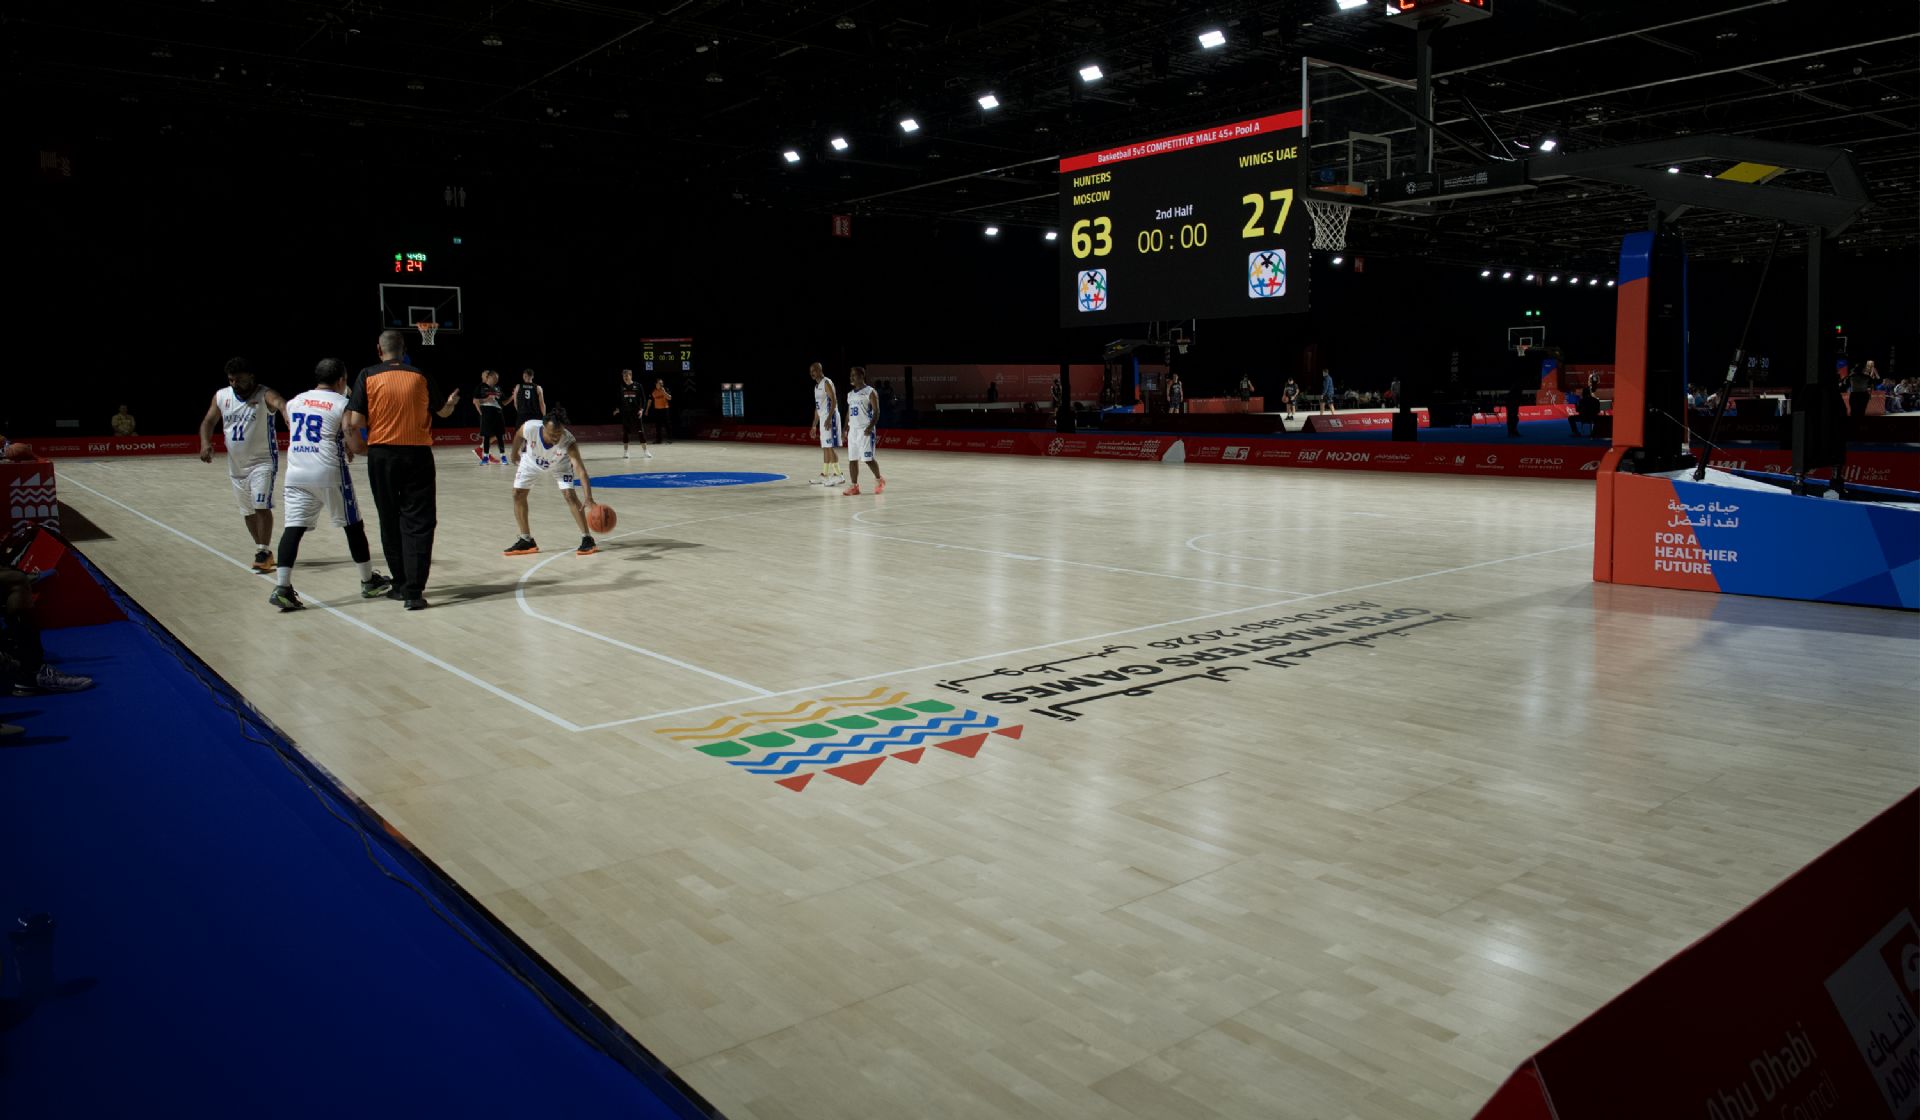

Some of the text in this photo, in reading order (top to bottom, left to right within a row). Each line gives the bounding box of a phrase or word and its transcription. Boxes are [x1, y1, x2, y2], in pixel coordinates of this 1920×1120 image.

[1097, 121, 1261, 163] Basketball 5v5 COMPETITIVE MALE 45+ Pool A
[1239, 147, 1298, 168] WINGS UAE
[1073, 171, 1112, 188] HUNTERS
[1073, 190, 1111, 206] MOSCOW
[1155, 204, 1194, 220] 2nd Half
[1241, 188, 1294, 239] 27
[1071, 216, 1113, 259] 63
[407, 260, 423, 272] 24
[643, 351, 654, 361] 63
[680, 350, 691, 361] 27
[524, 389, 531, 400] 9
[232, 424, 245, 442] 11
[292, 412, 323, 443] 78
[1667, 499, 1740, 515] حياة صحية
[1667, 514, 1712, 528] أفضل
[1655, 532, 1697, 545] FOR A
[1655, 546, 1739, 562] HEALTHIER
[1654, 560, 1712, 575] FUTURE
[1146, 600, 1382, 650] Abu Dhabi 2026
[981, 607, 1432, 704] OPEN MASTERS GAMES
[1750, 1021, 1818, 1102] Dhabi
